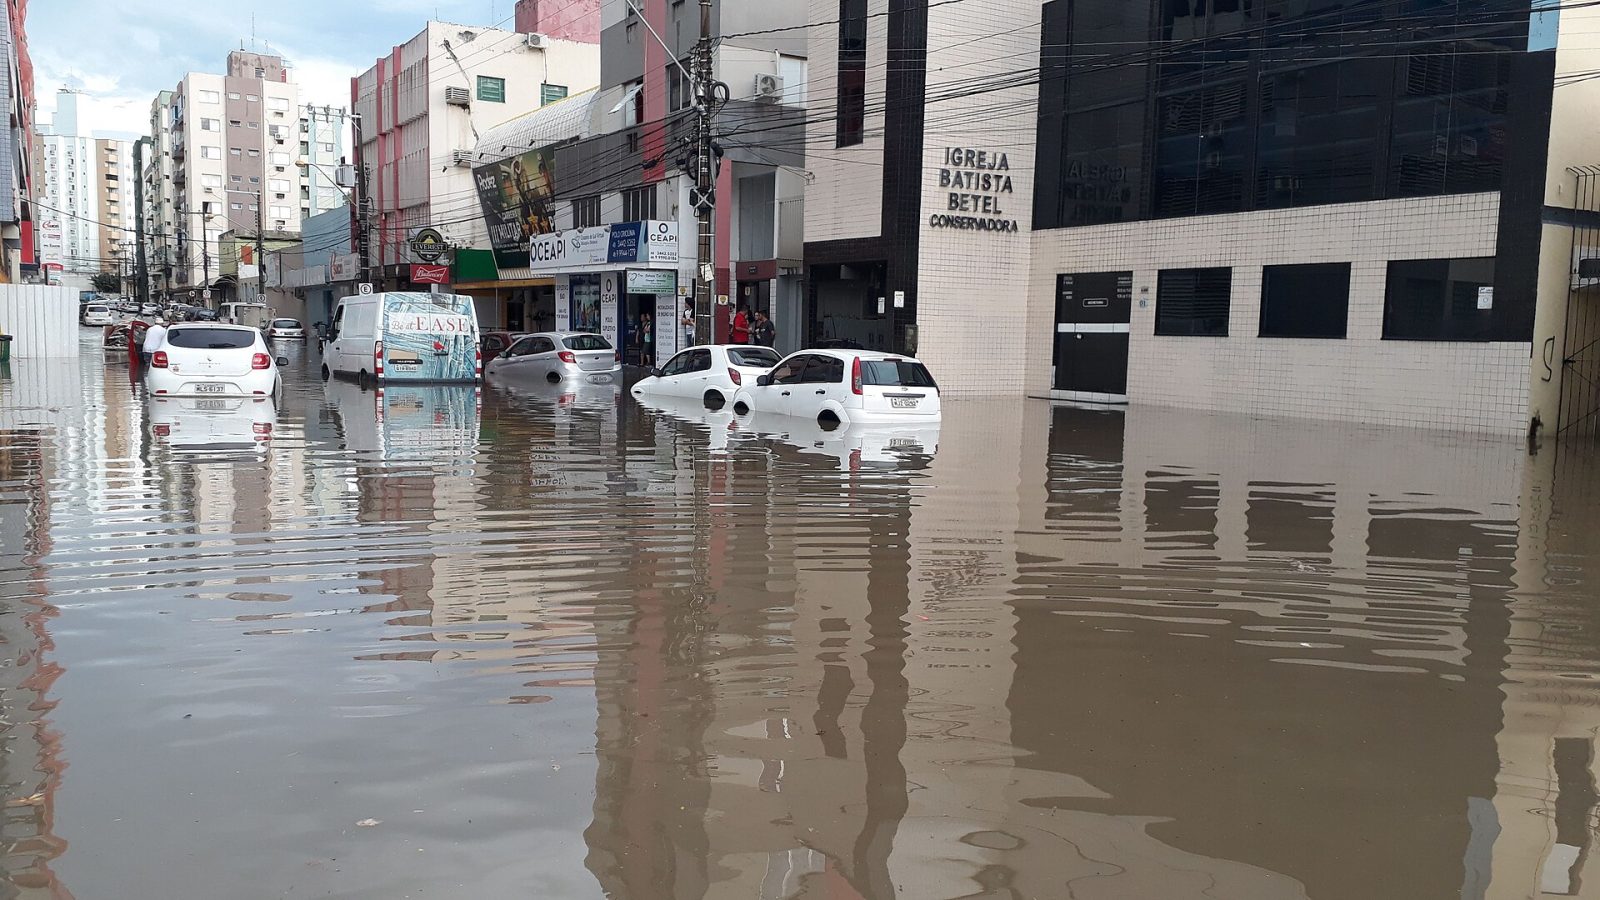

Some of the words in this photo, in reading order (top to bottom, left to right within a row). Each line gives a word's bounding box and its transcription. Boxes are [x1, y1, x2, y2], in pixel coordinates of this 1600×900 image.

[944, 147, 1009, 171] IGREJA
[939, 168, 1013, 194] BATISTA
[947, 192, 1002, 215] BETEL
[929, 213, 1019, 233] CONSERVADORA
[650, 233, 677, 242] CEAPI
[602, 293, 617, 303] CEAPI
[392, 320, 404, 330] Be
[405, 320, 414, 330] at
[416, 317, 469, 332] EASE
